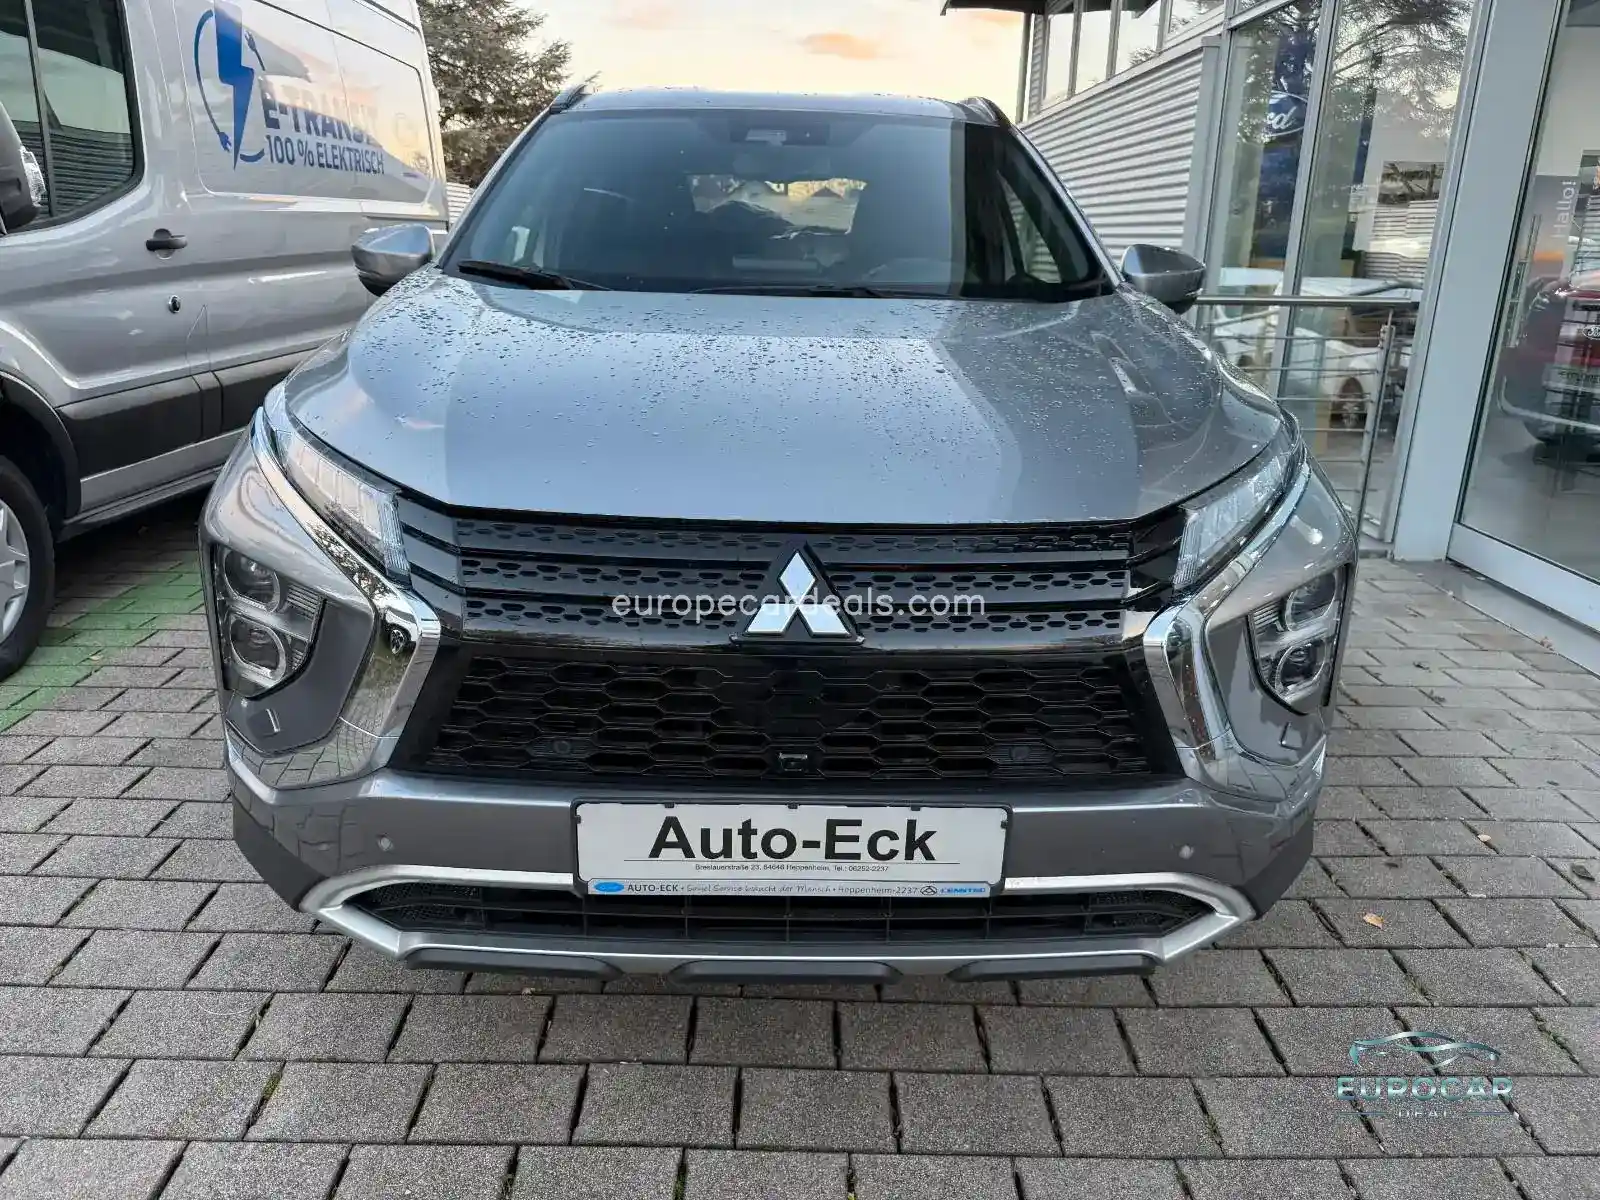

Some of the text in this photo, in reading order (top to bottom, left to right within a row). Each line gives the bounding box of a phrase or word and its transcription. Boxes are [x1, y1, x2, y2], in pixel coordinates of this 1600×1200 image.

[265, 134, 385, 175] 100 % ELEKTRISCH
[1549, 181, 1576, 238] Hallo!
[648, 815, 938, 862] Auto-Eck
[627, 883, 679, 892] AUTO-ECK
